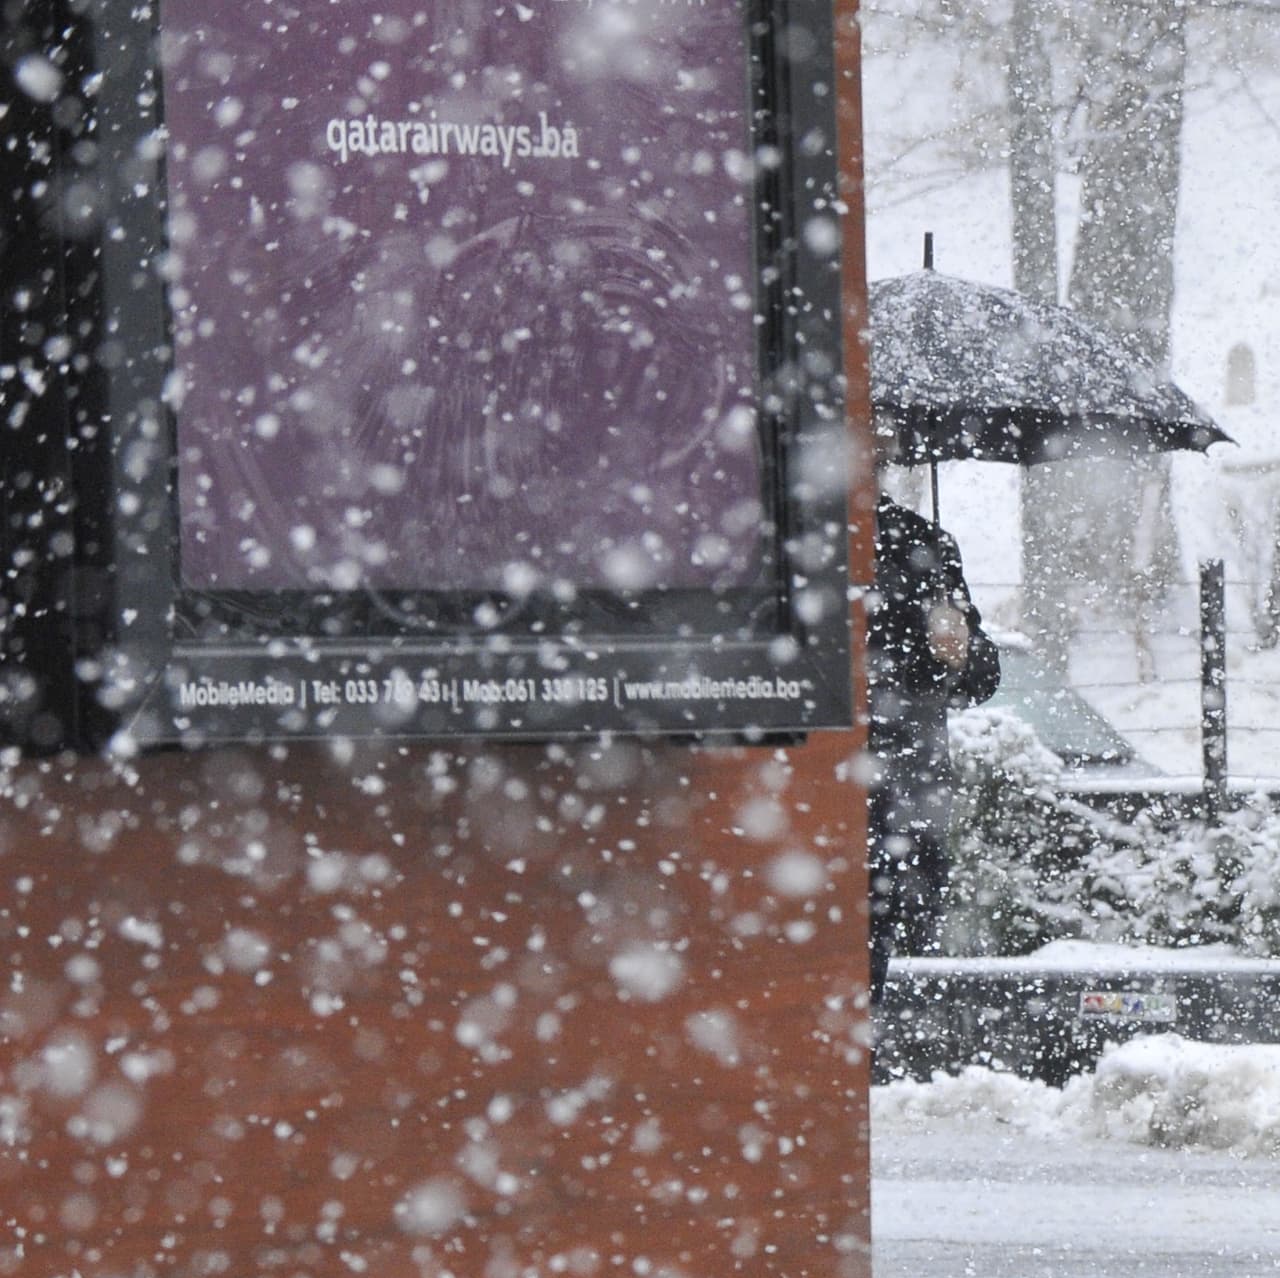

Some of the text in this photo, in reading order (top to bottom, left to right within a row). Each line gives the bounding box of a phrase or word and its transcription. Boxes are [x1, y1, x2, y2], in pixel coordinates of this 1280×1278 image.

[325, 110, 579, 168] qatarairways.ba
[180, 679, 294, 705] MobileMedia
[345, 680, 378, 702] 033
[577, 678, 608, 701] 125
[624, 677, 800, 700] www.mobilemedia.ba
